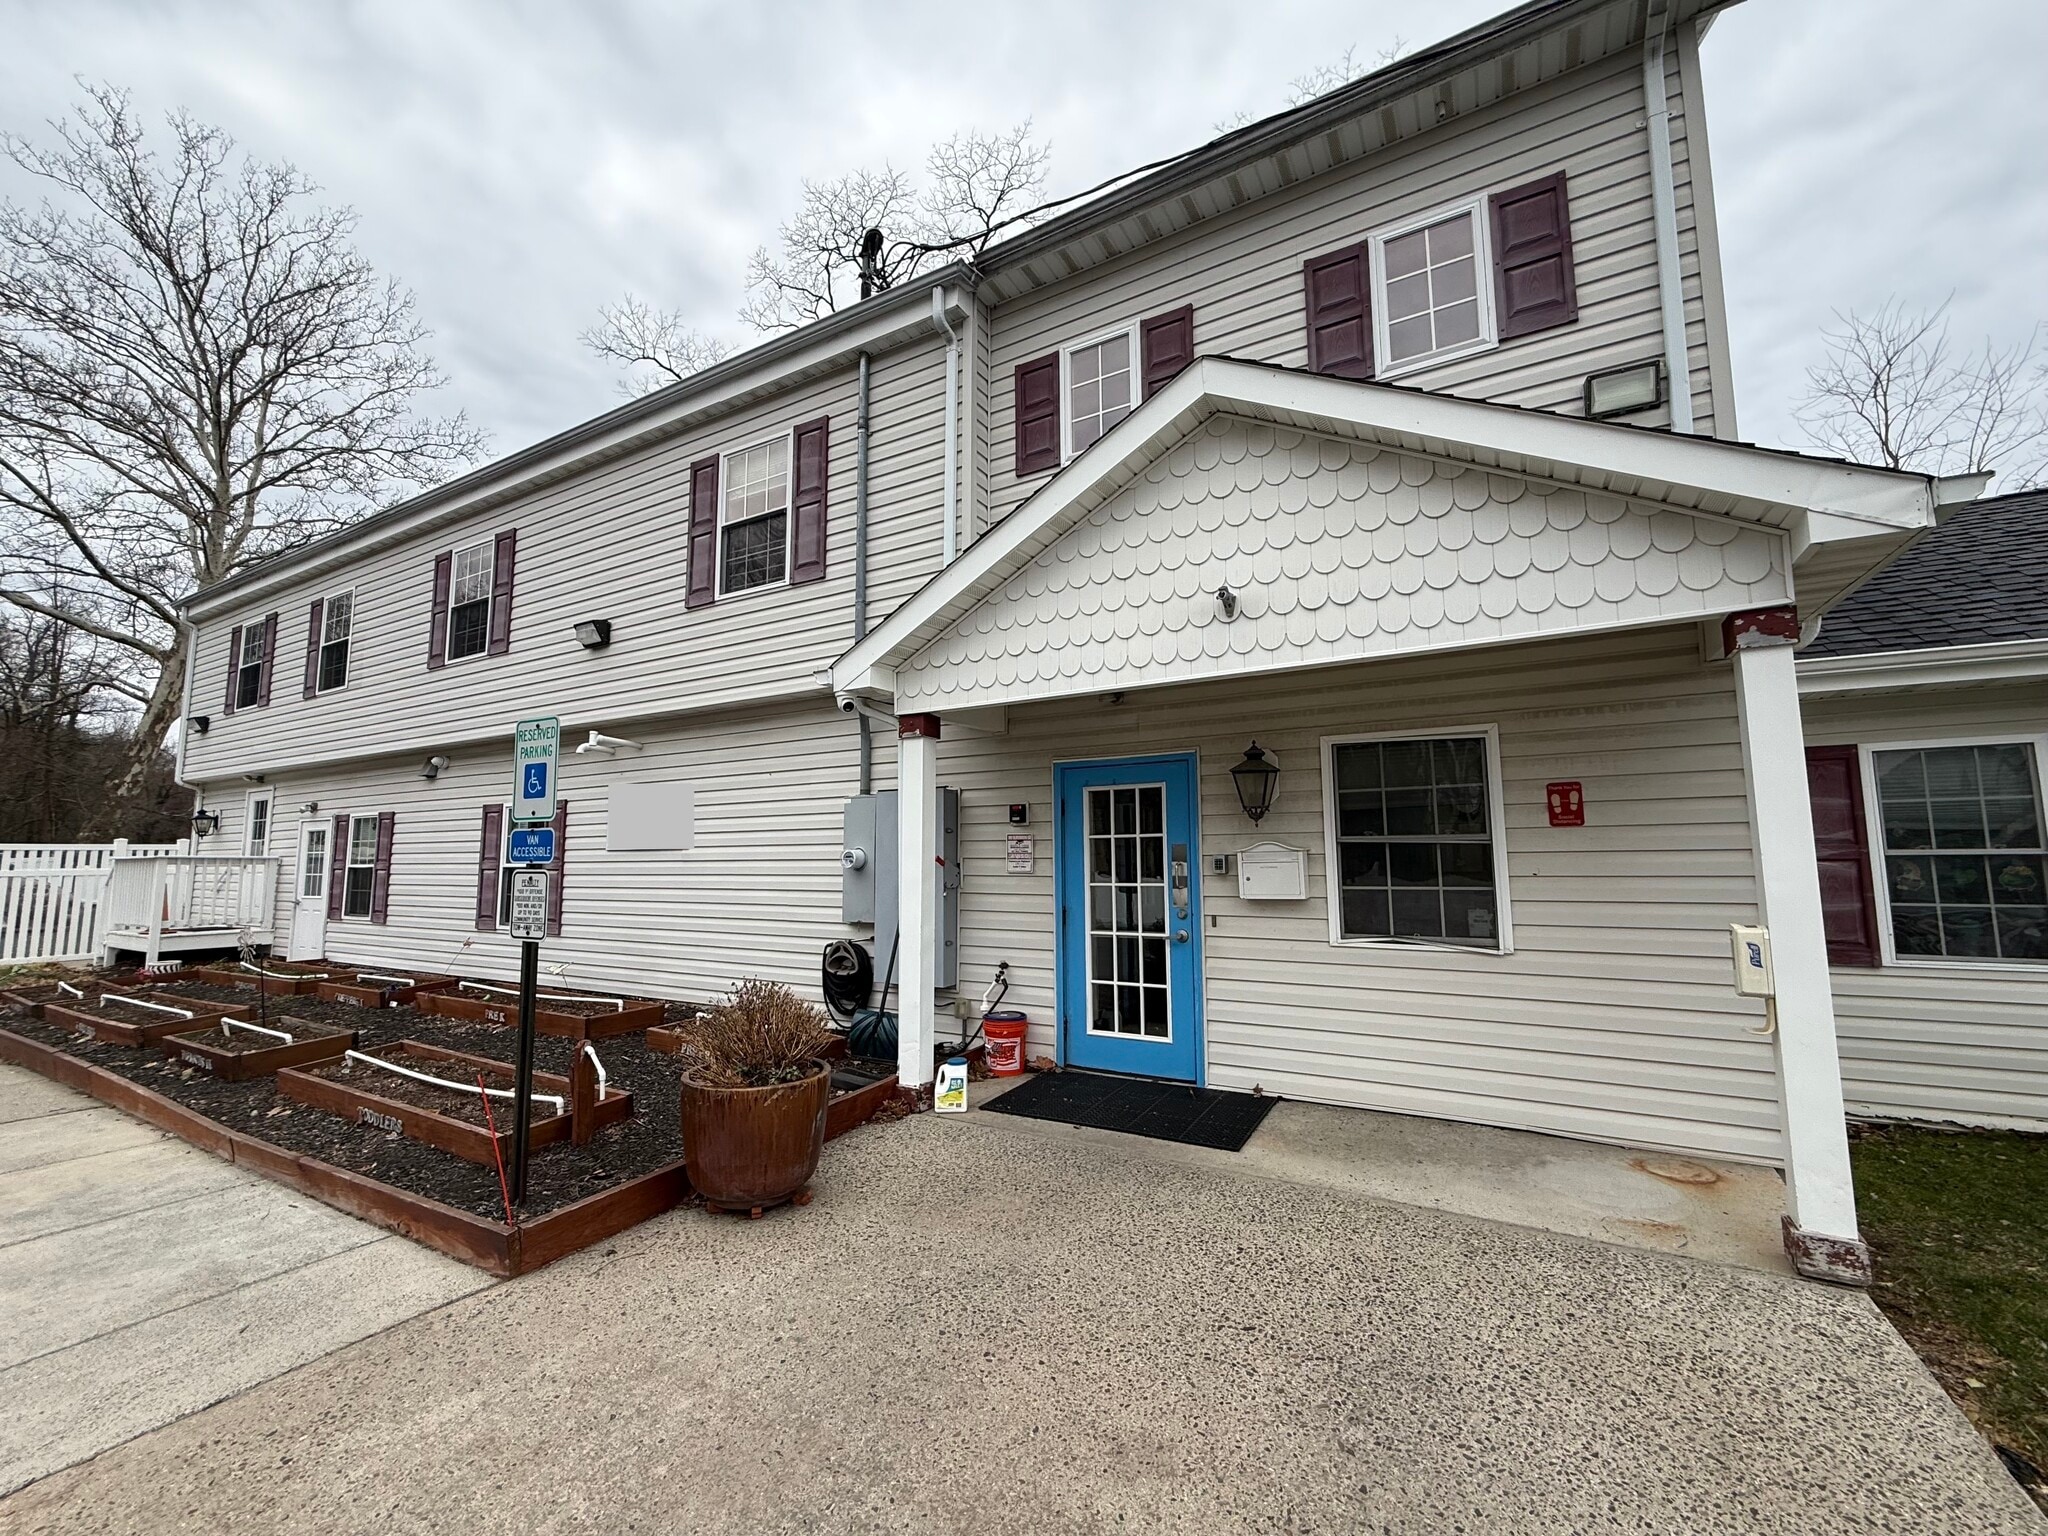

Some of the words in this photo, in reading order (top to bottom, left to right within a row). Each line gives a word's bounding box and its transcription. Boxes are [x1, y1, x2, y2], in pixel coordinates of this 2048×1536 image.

[518, 726, 556, 742] RESERVED
[519, 743, 553, 760] PARKING
[526, 834, 539, 845] VAN
[512, 846, 551, 857] ACCESSIBLE
[356, 1105, 403, 1134] TODDLERS
